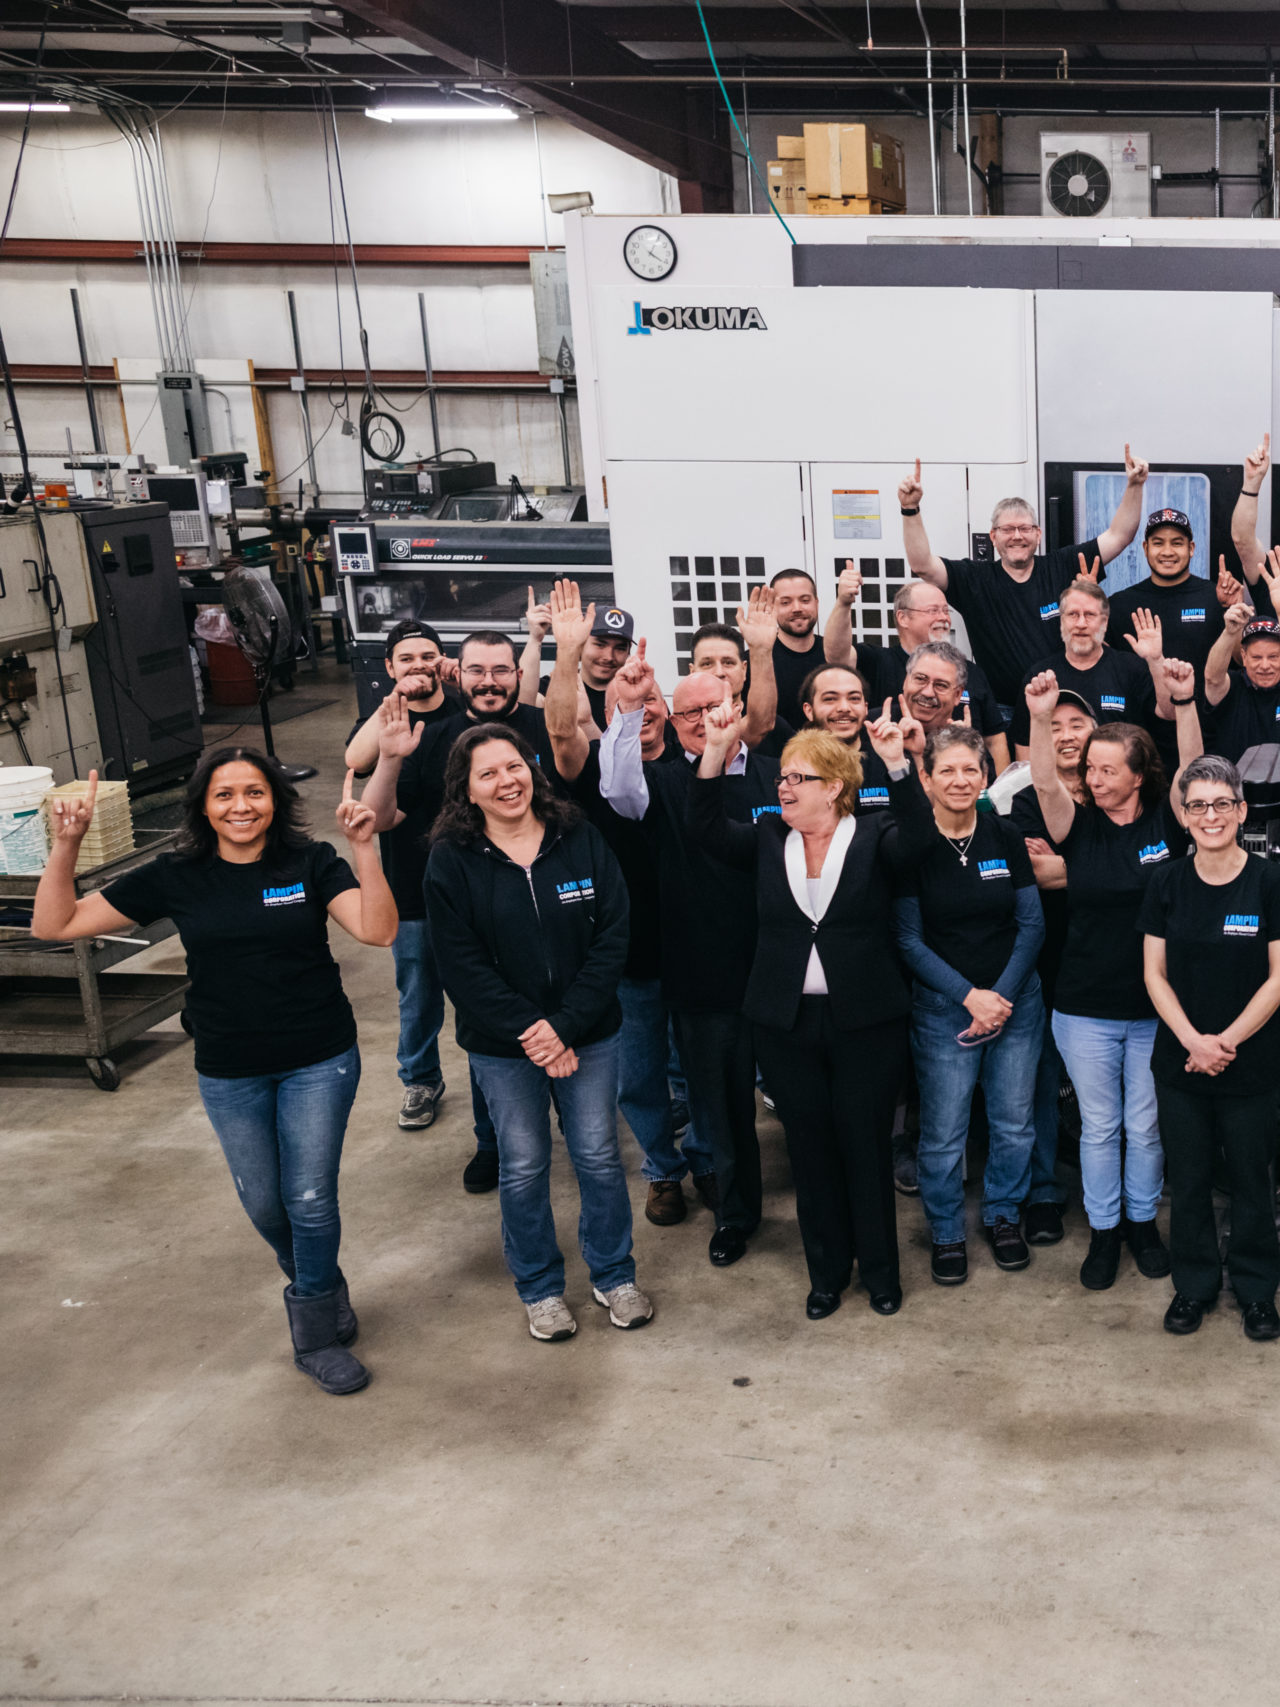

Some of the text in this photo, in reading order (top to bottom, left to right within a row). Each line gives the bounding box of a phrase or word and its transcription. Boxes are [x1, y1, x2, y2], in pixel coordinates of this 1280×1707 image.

[651, 307, 768, 331] OKUMA
[1101, 696, 1126, 705] LAMPIN
[859, 787, 890, 798] LAMPIN
[263, 882, 305, 899] LAMPIN
[1224, 915, 1259, 927] LAMPIN
